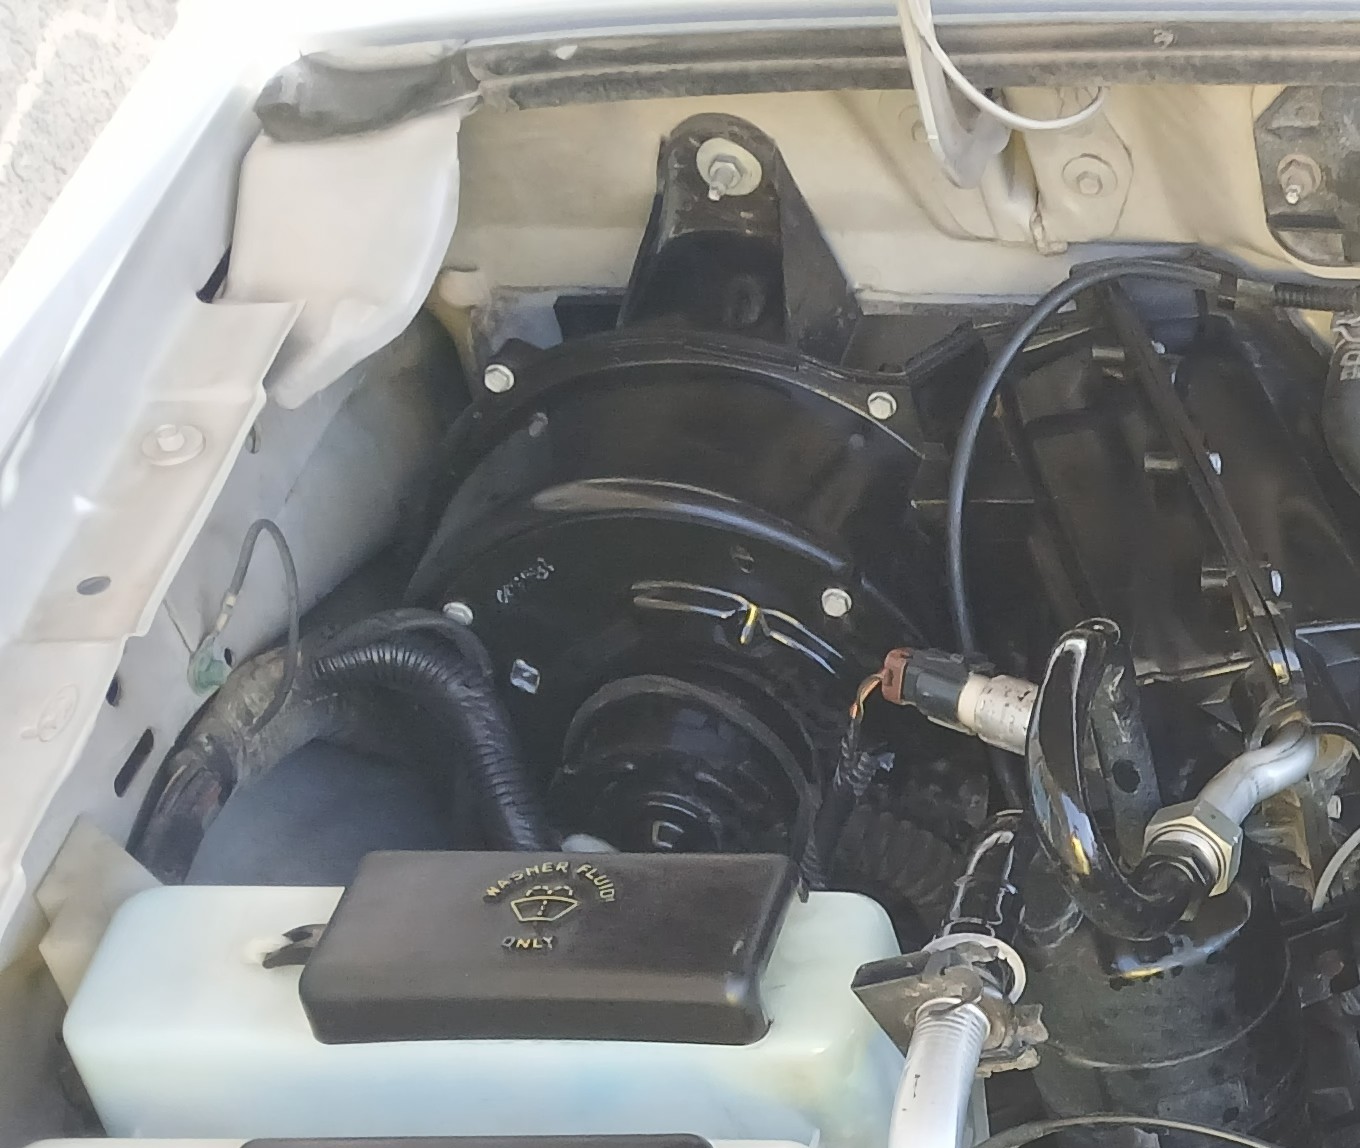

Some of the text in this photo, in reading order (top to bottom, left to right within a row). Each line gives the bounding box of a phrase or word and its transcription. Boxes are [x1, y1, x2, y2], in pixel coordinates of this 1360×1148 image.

[486, 861, 615, 902] WASHER FLUID
[502, 936, 553, 949] ONLY
